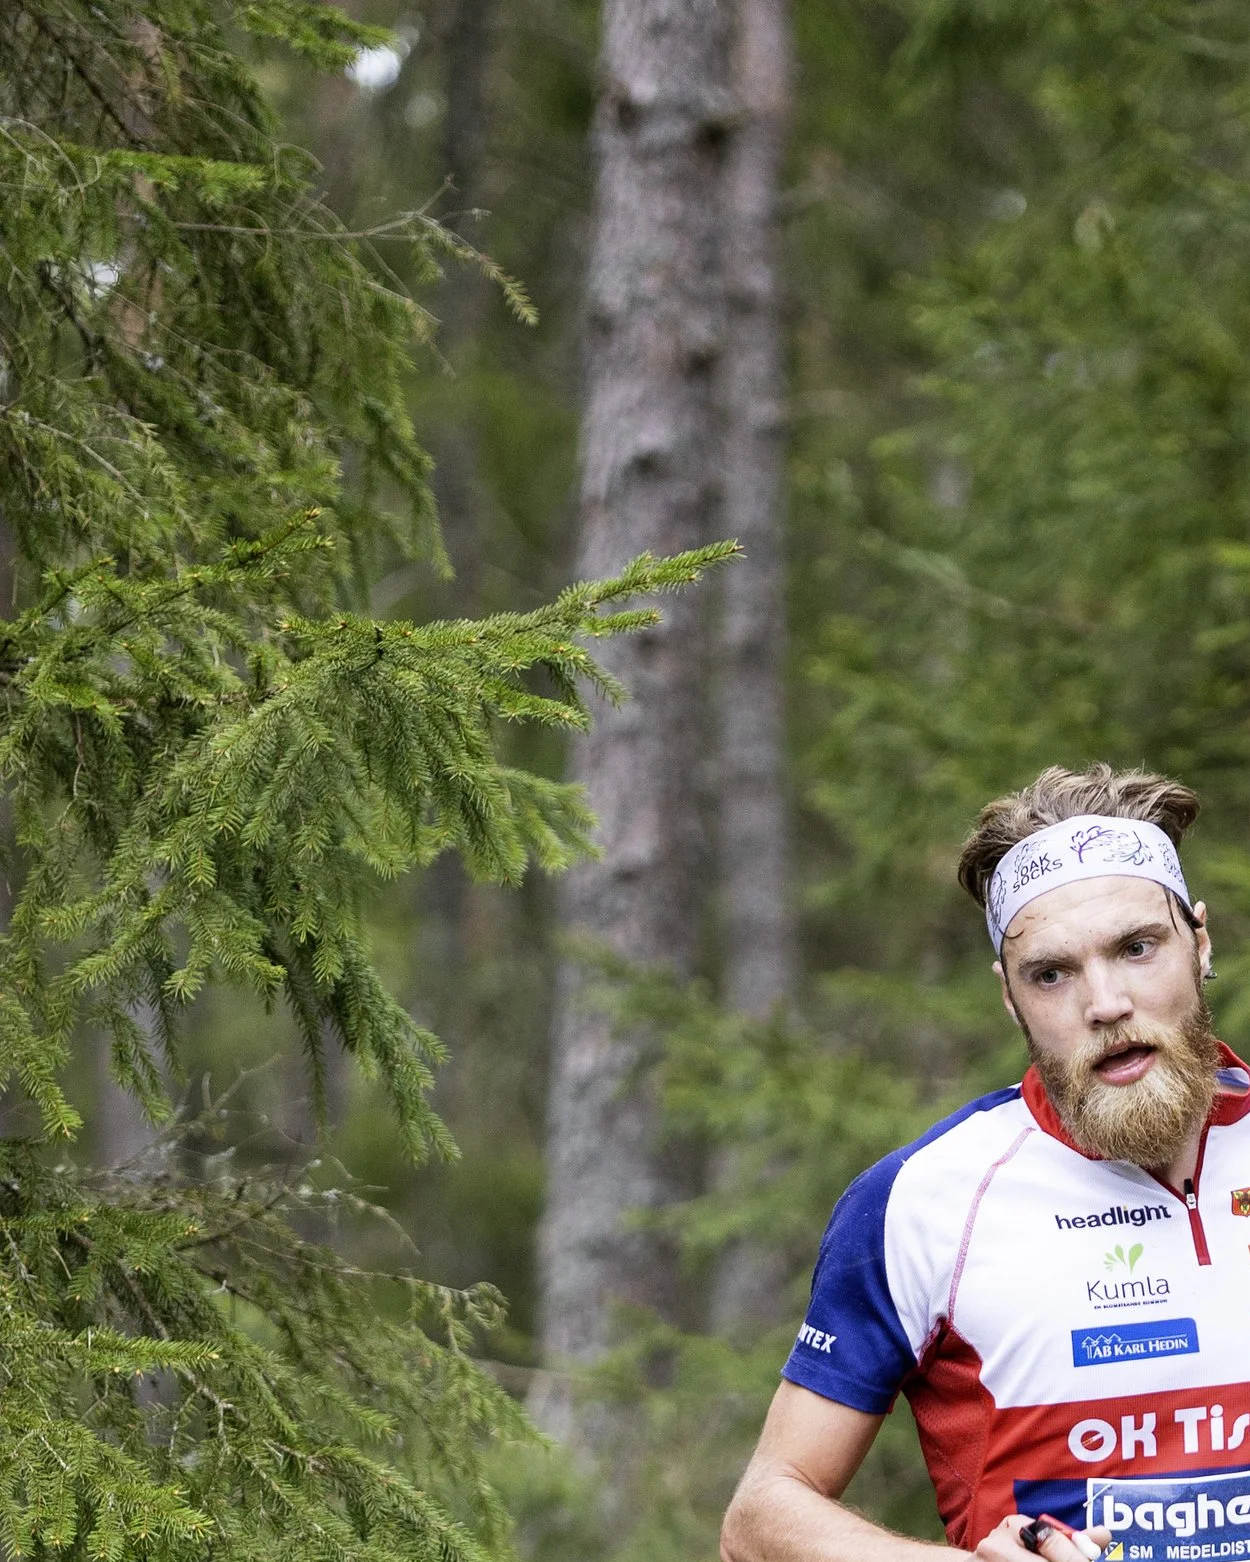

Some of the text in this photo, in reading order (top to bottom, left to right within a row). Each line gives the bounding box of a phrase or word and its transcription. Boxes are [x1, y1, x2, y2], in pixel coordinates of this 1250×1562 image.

[1012, 858, 1063, 893] SOCKS
[1020, 852, 1051, 877] OAK
[1054, 1204, 1172, 1230] headlight
[1086, 1275, 1171, 1302] Kumla
[1093, 1337, 1189, 1359] AB KARL HEDIN
[1067, 1411, 1158, 1463] OK
[1129, 1544, 1153, 1560] SM
